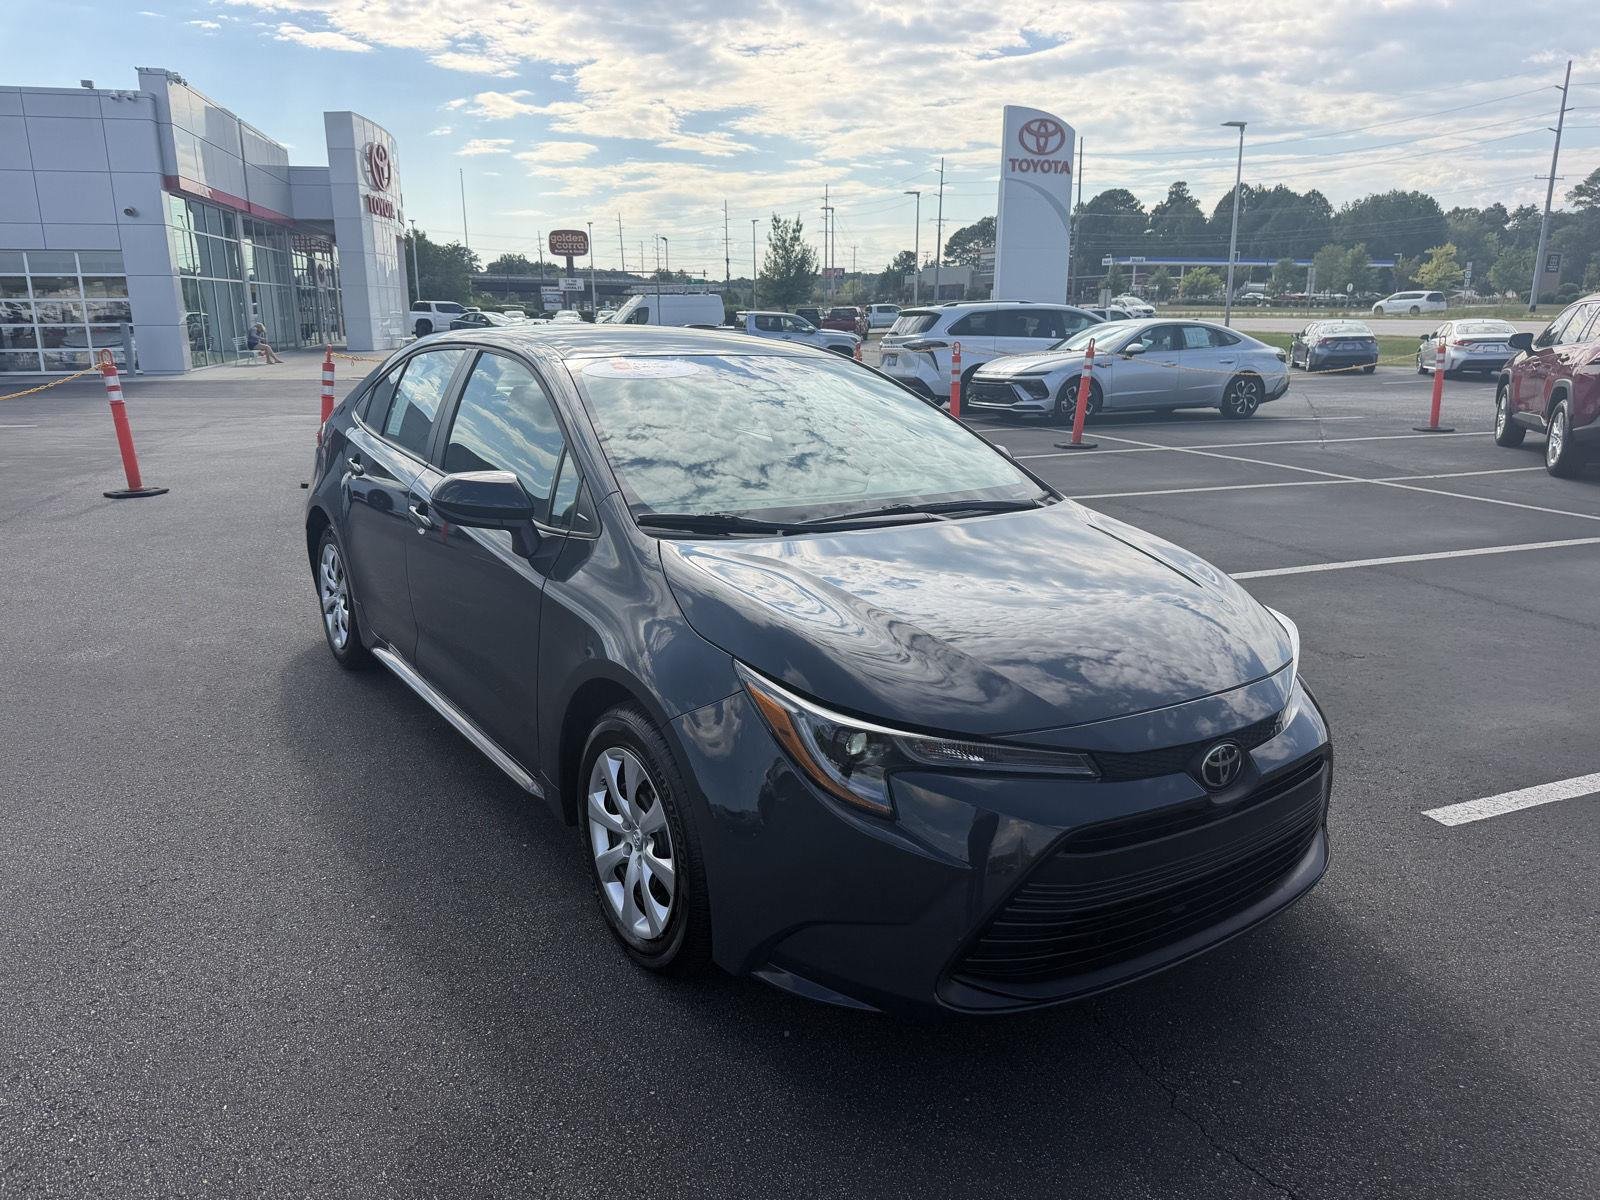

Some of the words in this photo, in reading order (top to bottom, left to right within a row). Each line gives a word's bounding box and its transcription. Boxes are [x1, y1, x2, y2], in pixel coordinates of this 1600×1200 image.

[1009, 158, 1070, 174] TOYOTA
[551, 234, 584, 243] golden
[556, 241, 588, 249] corral
